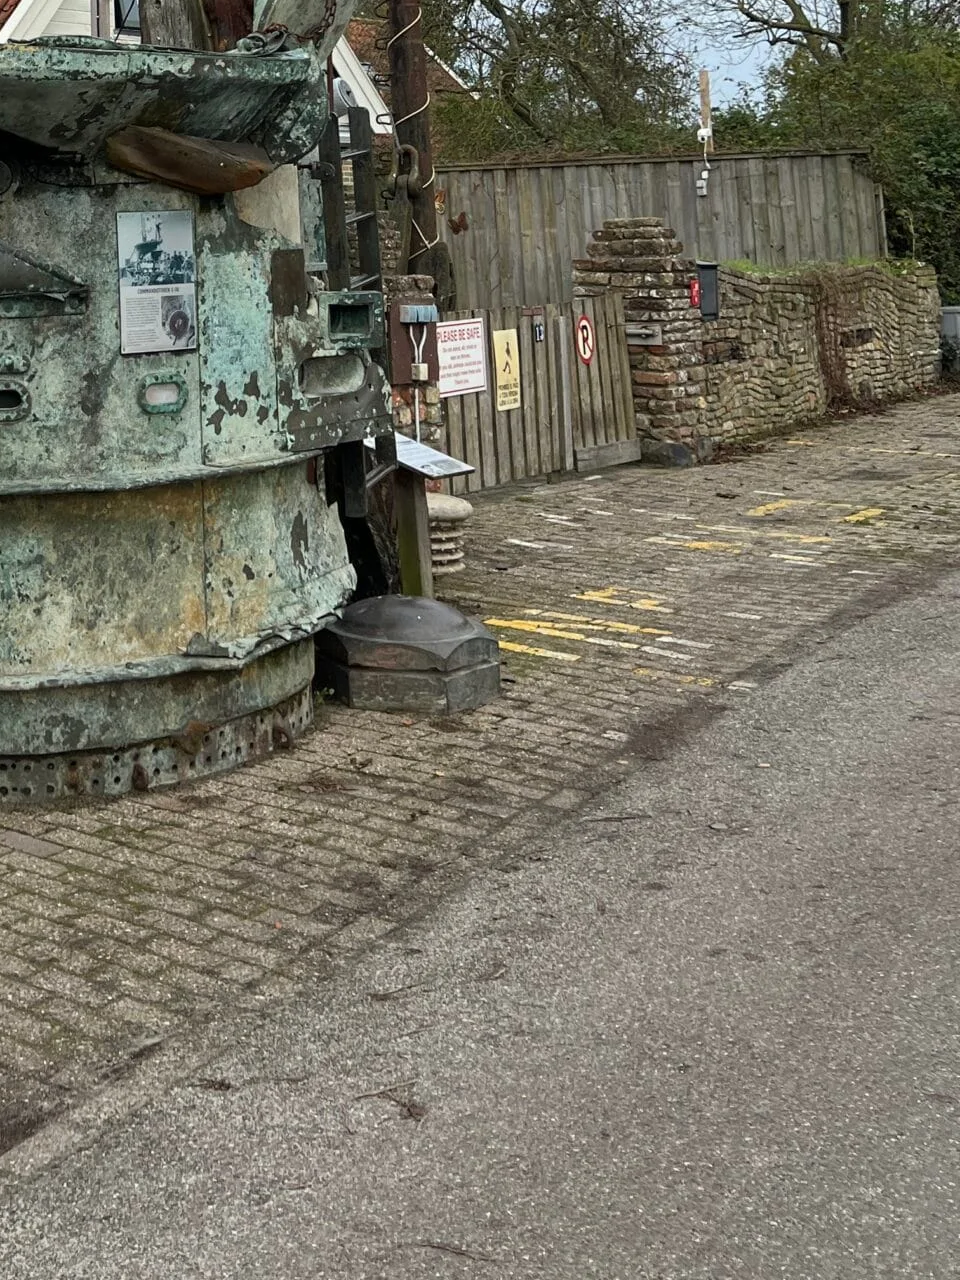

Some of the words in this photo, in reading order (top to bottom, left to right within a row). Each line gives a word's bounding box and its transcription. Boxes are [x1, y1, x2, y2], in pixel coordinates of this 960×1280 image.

[458, 328, 466, 341] BE
[466, 327, 481, 340] SAFE
[582, 325, 589, 355] P
